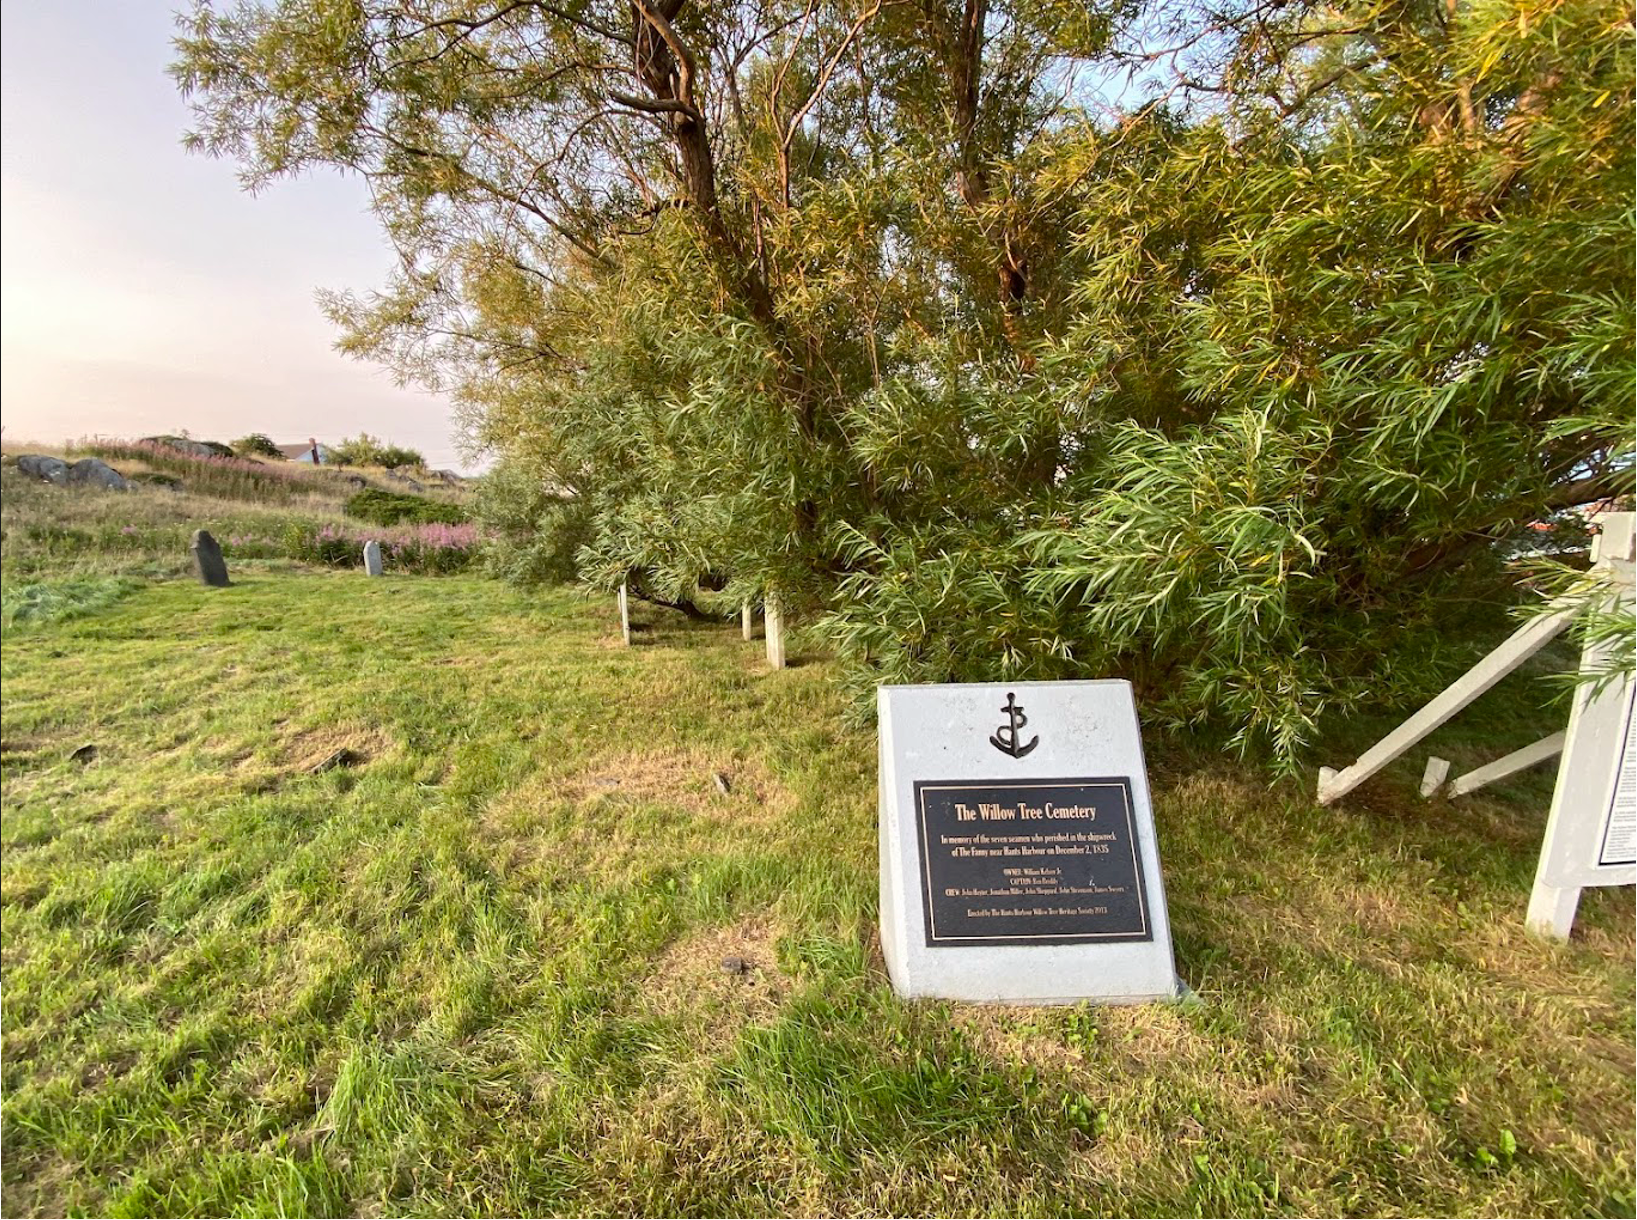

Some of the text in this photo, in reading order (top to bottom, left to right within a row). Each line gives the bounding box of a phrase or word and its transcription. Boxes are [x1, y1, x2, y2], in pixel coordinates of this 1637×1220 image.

[955, 802, 1096, 821] The Willow Tree Cemetery
[941, 834, 948, 844] In
[948, 837, 972, 845] memory
[973, 834, 980, 844] of
[980, 834, 990, 844] the
[1008, 835, 1030, 843] seamen
[1031, 833, 1043, 842] who
[1044, 832, 1069, 844] perished
[1070, 833, 1077, 842] in
[1077, 832, 1086, 842] the
[1088, 831, 1117, 842] shipwreck
[951, 847, 959, 857] of
[958, 846, 971, 857] The
[971, 846, 988, 858] Fanny
[1004, 846, 1021, 856] Hants
[1022, 846, 1046, 855] Harbour
[1055, 844, 1084, 854] December
[1084, 844, 1092, 854] 2,
[1093, 844, 1109, 854] 1835
